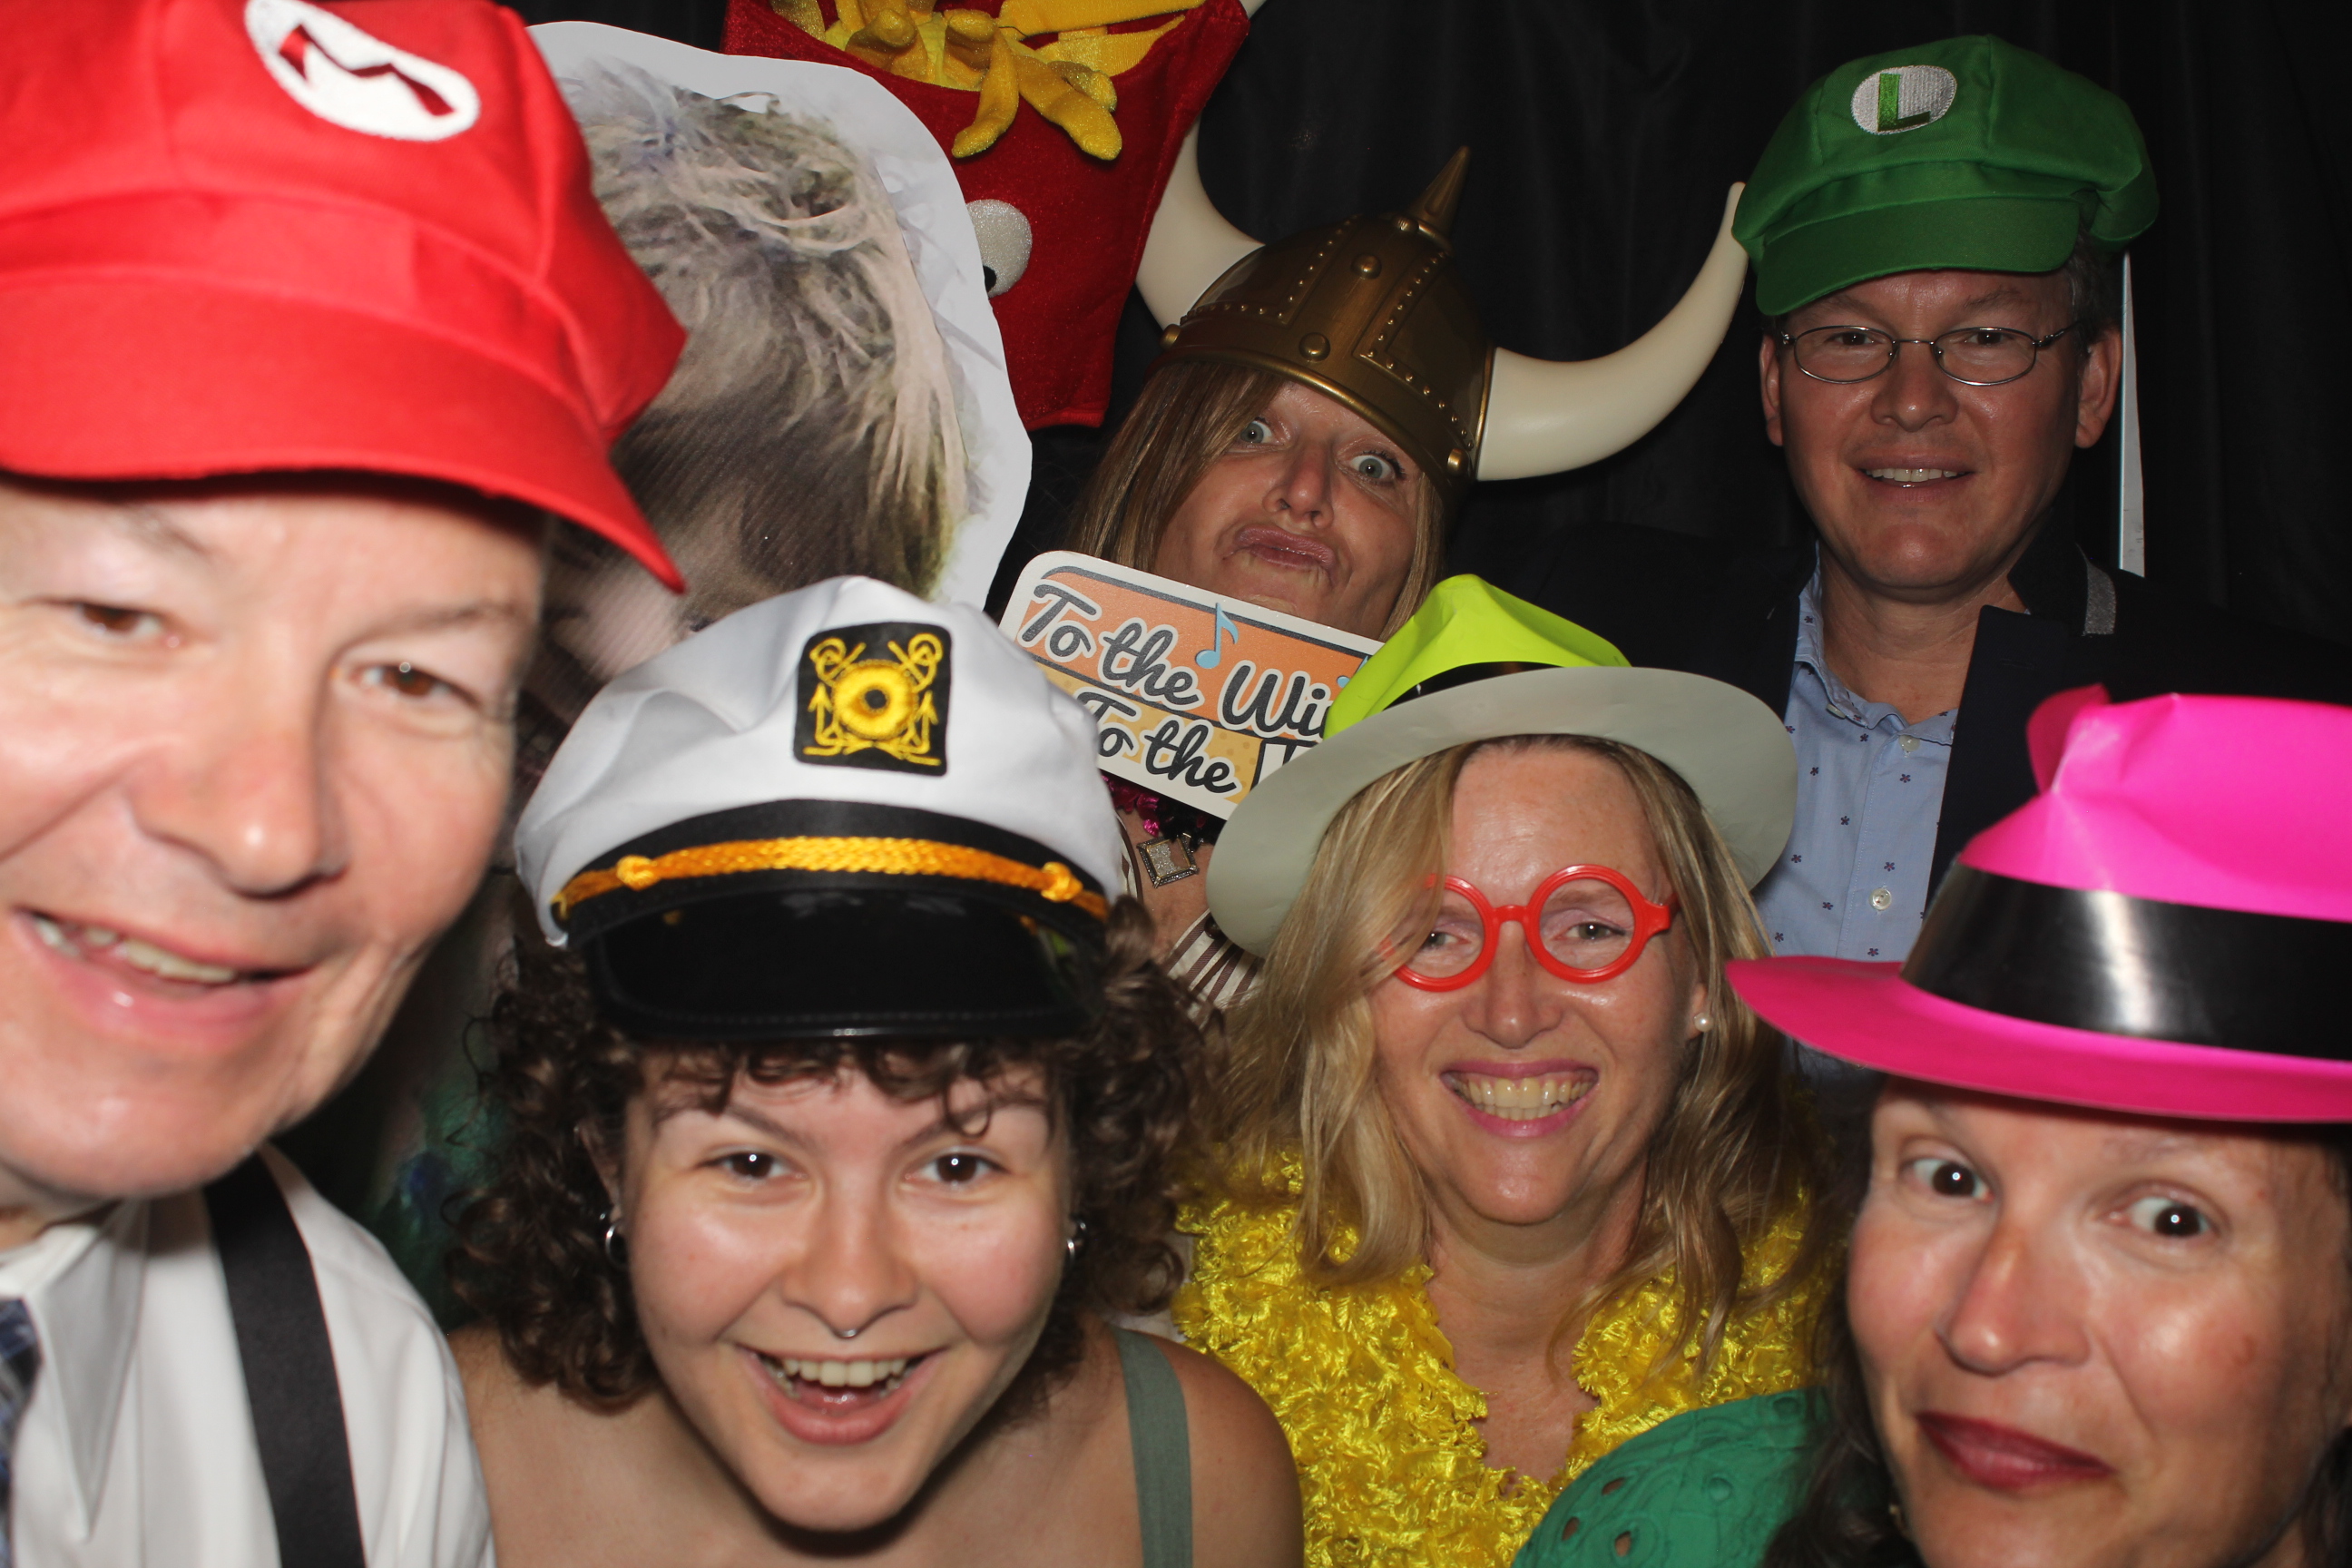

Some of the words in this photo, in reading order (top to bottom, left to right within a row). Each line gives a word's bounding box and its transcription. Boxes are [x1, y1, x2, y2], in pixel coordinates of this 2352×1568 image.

[1877, 73, 1932, 132] L
[1021, 583, 1097, 657] To
[1102, 622, 1200, 706] the
[1221, 664, 1332, 740] Wi
[1143, 720, 1238, 794] the
